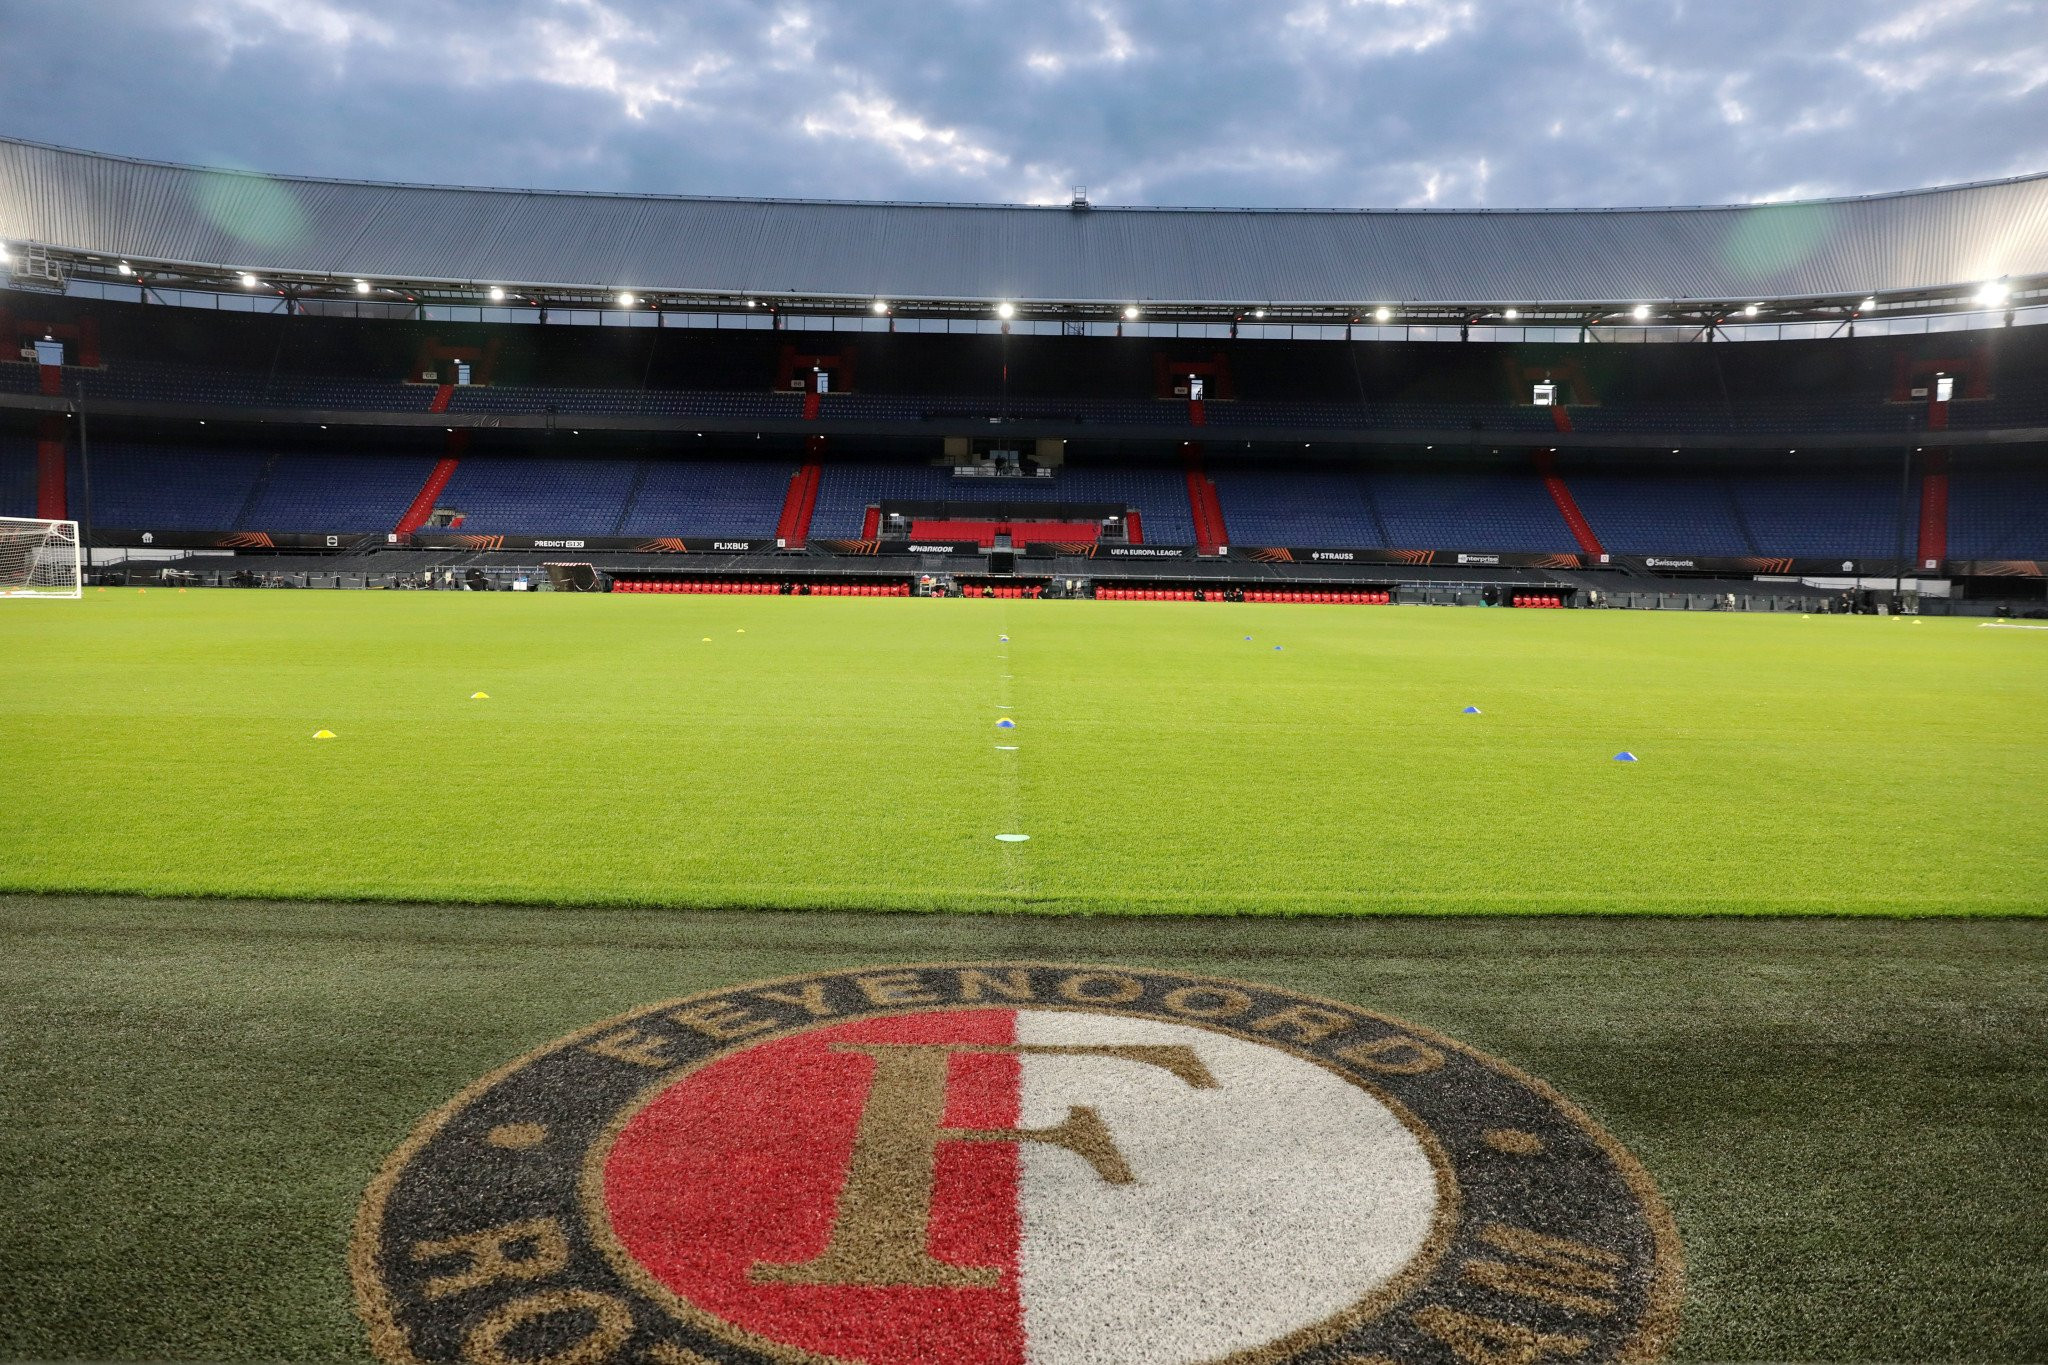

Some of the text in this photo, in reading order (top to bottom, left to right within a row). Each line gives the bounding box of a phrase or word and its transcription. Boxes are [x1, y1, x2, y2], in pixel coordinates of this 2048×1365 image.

[714, 542, 749, 550] FLIXBUS
[1320, 552, 1354, 560] STRAUSS
[1655, 558, 1694, 567] Swissquote
[584, 967, 1446, 1075] FEYENOORD
[748, 1043, 1220, 1289] F
